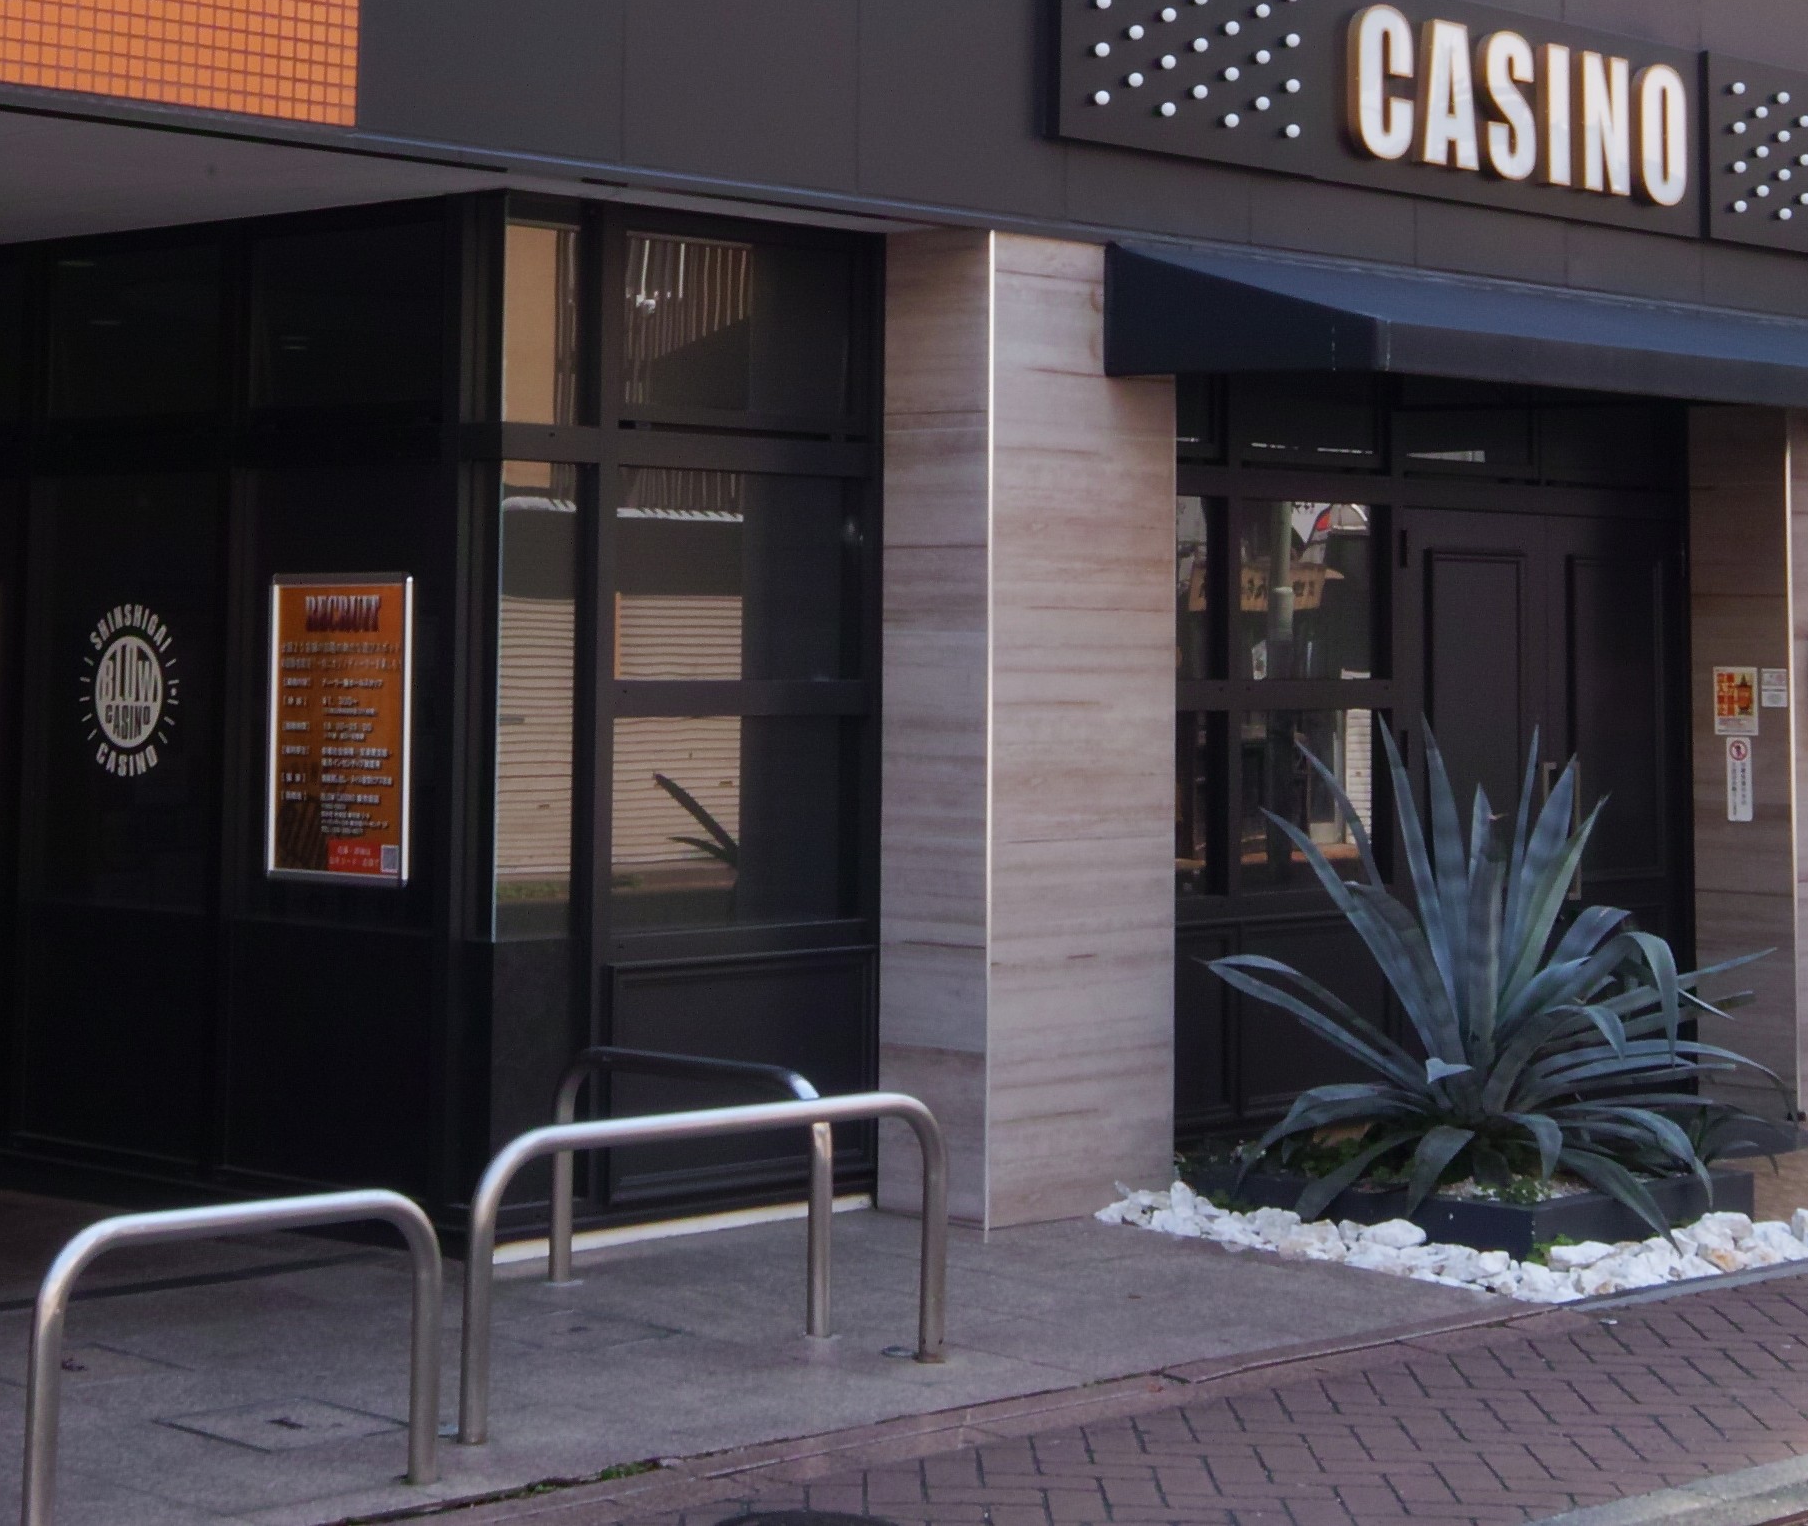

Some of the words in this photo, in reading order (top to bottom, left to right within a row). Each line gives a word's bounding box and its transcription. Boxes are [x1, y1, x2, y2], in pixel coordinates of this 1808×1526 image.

[1346, 4, 1688, 207] CASINO
[88, 603, 173, 654] SHINSHIGAI
[305, 595, 380, 632] RECRUIT
[104, 704, 150, 740] CASINO
[95, 742, 156, 777] CASINO
